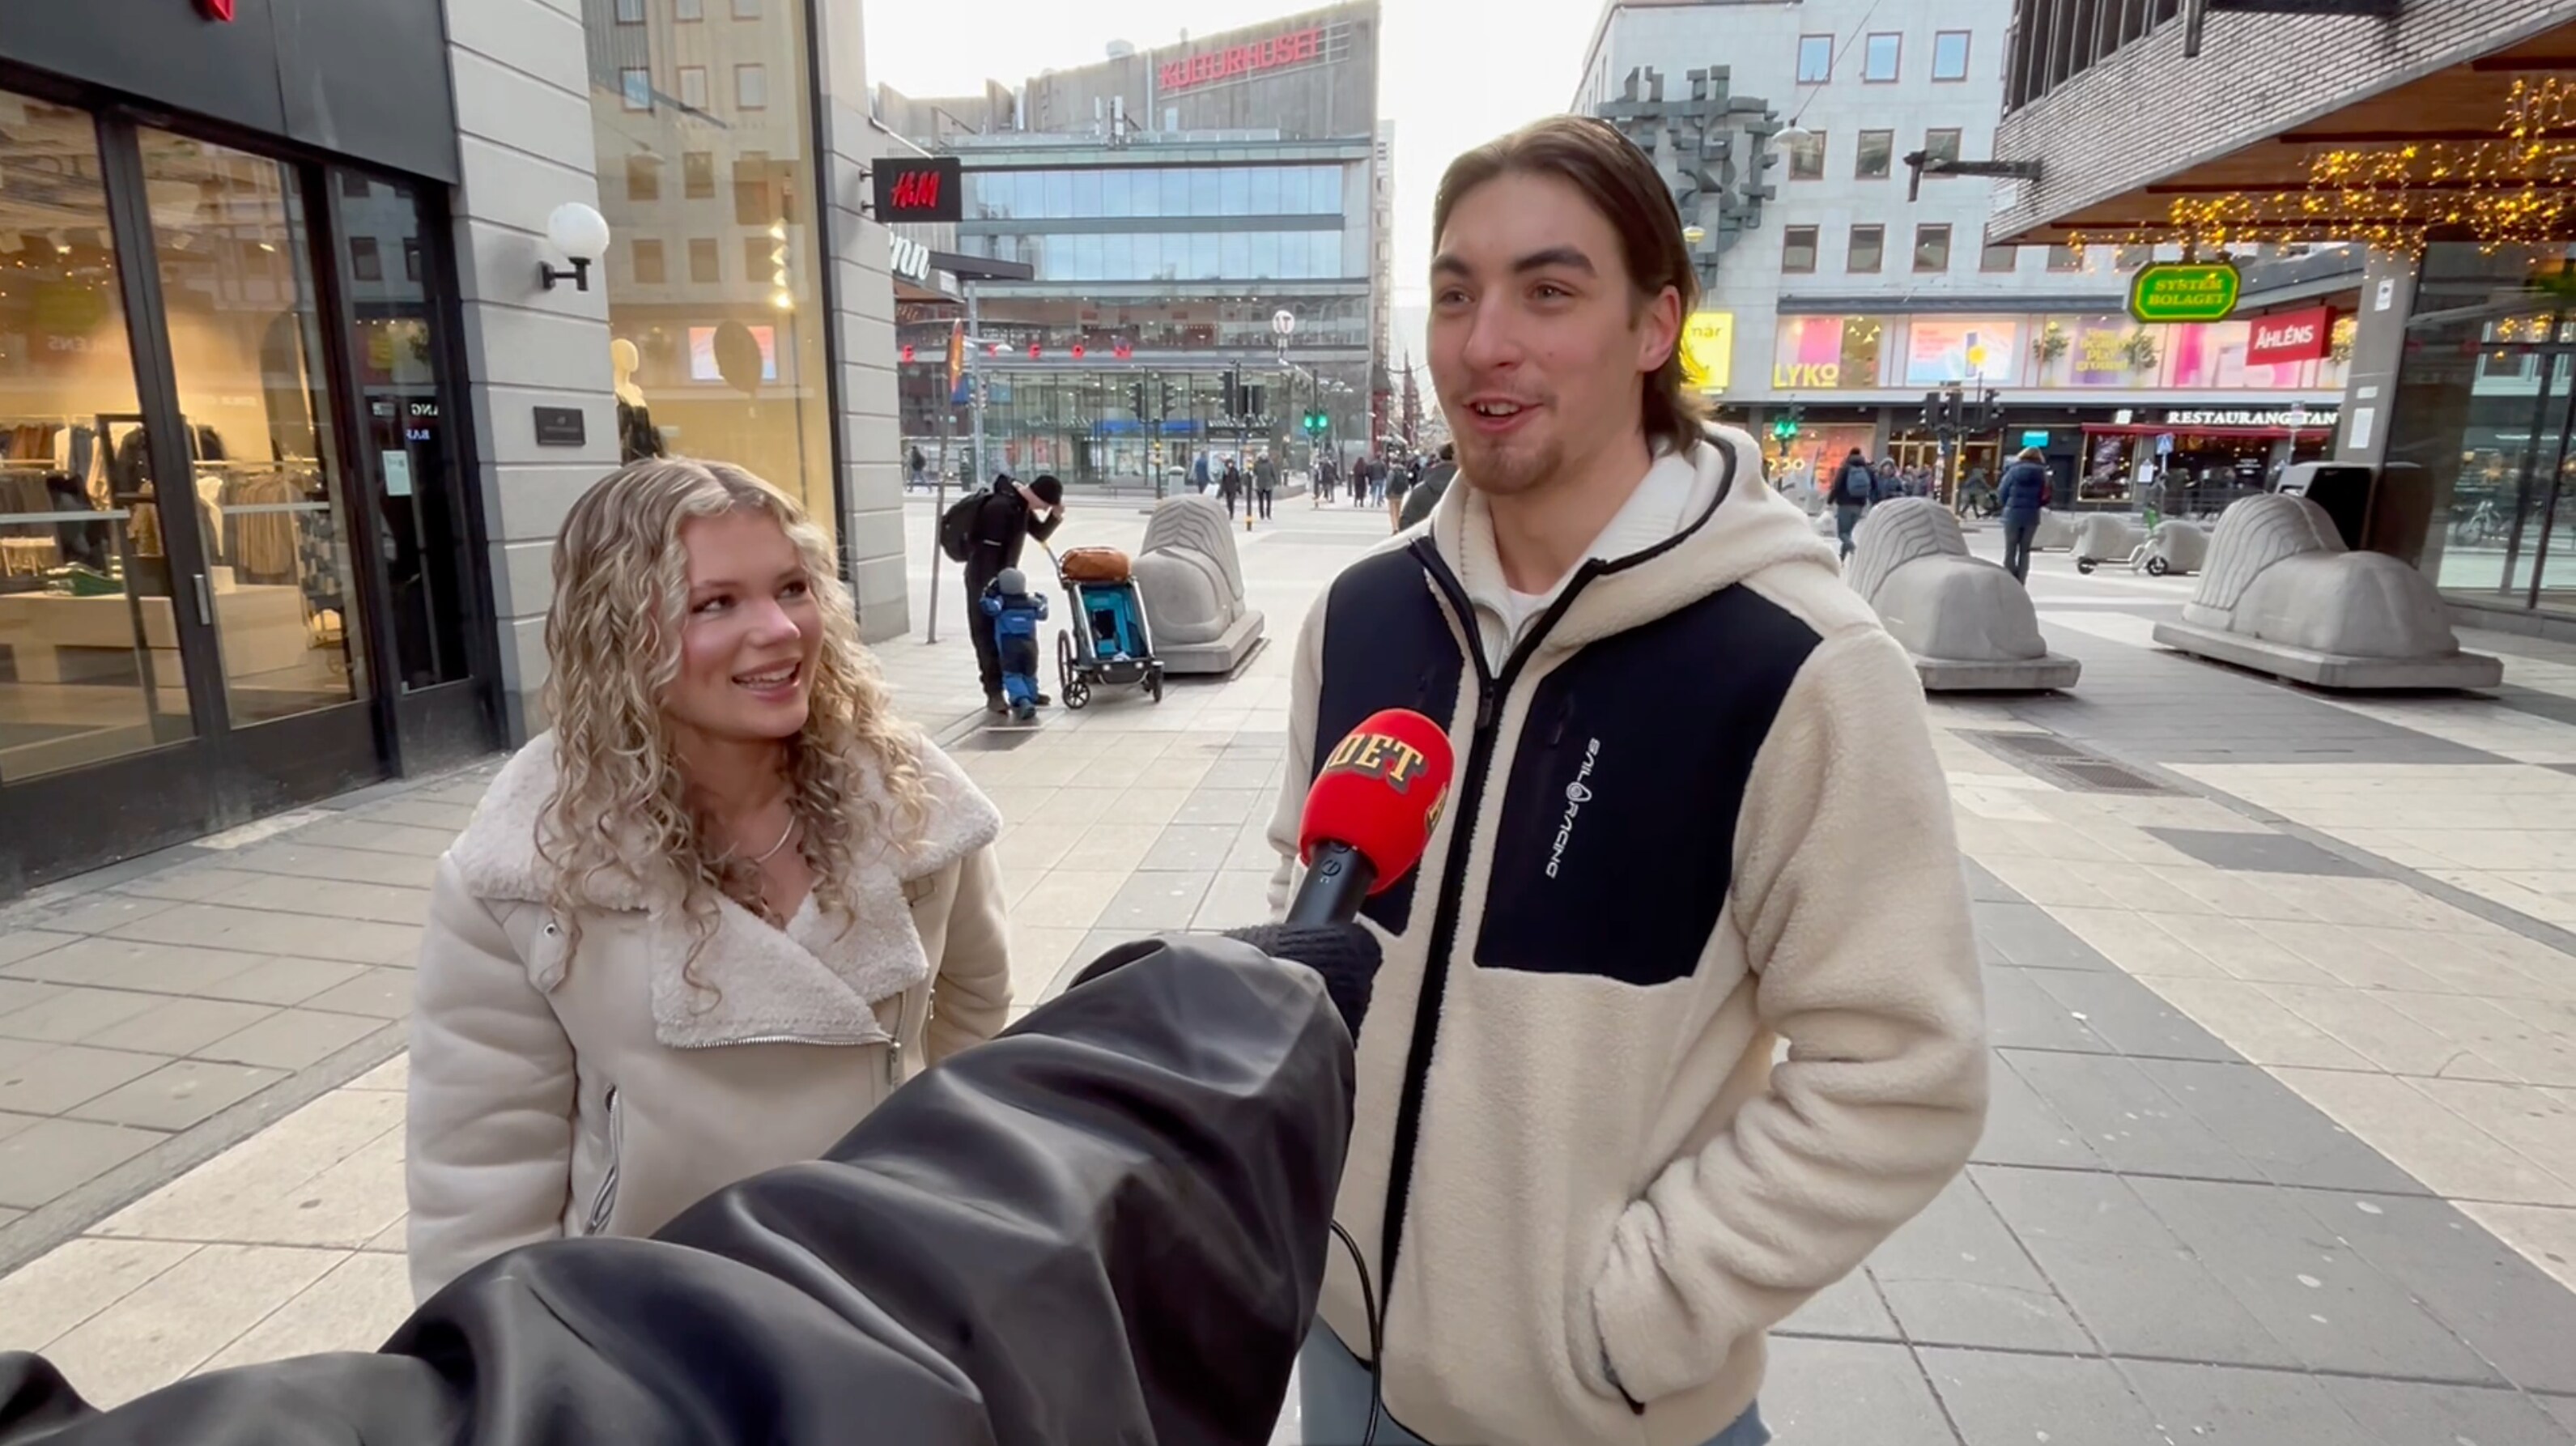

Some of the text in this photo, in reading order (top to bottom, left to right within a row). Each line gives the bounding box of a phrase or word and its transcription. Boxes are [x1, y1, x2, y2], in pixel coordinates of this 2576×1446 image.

[1159, 27, 1323, 89] KULTURHUSET
[891, 171, 940, 208] H&M
[2154, 279, 2223, 291] SYSTEM
[2148, 293, 2226, 305] BOLAGET
[2254, 325, 2314, 349] ÅHLÉNS
[1773, 363, 1838, 388] LYKO
[2167, 410, 2291, 425] RESTAURANG
[1545, 738, 1600, 879] SAIL RACING
